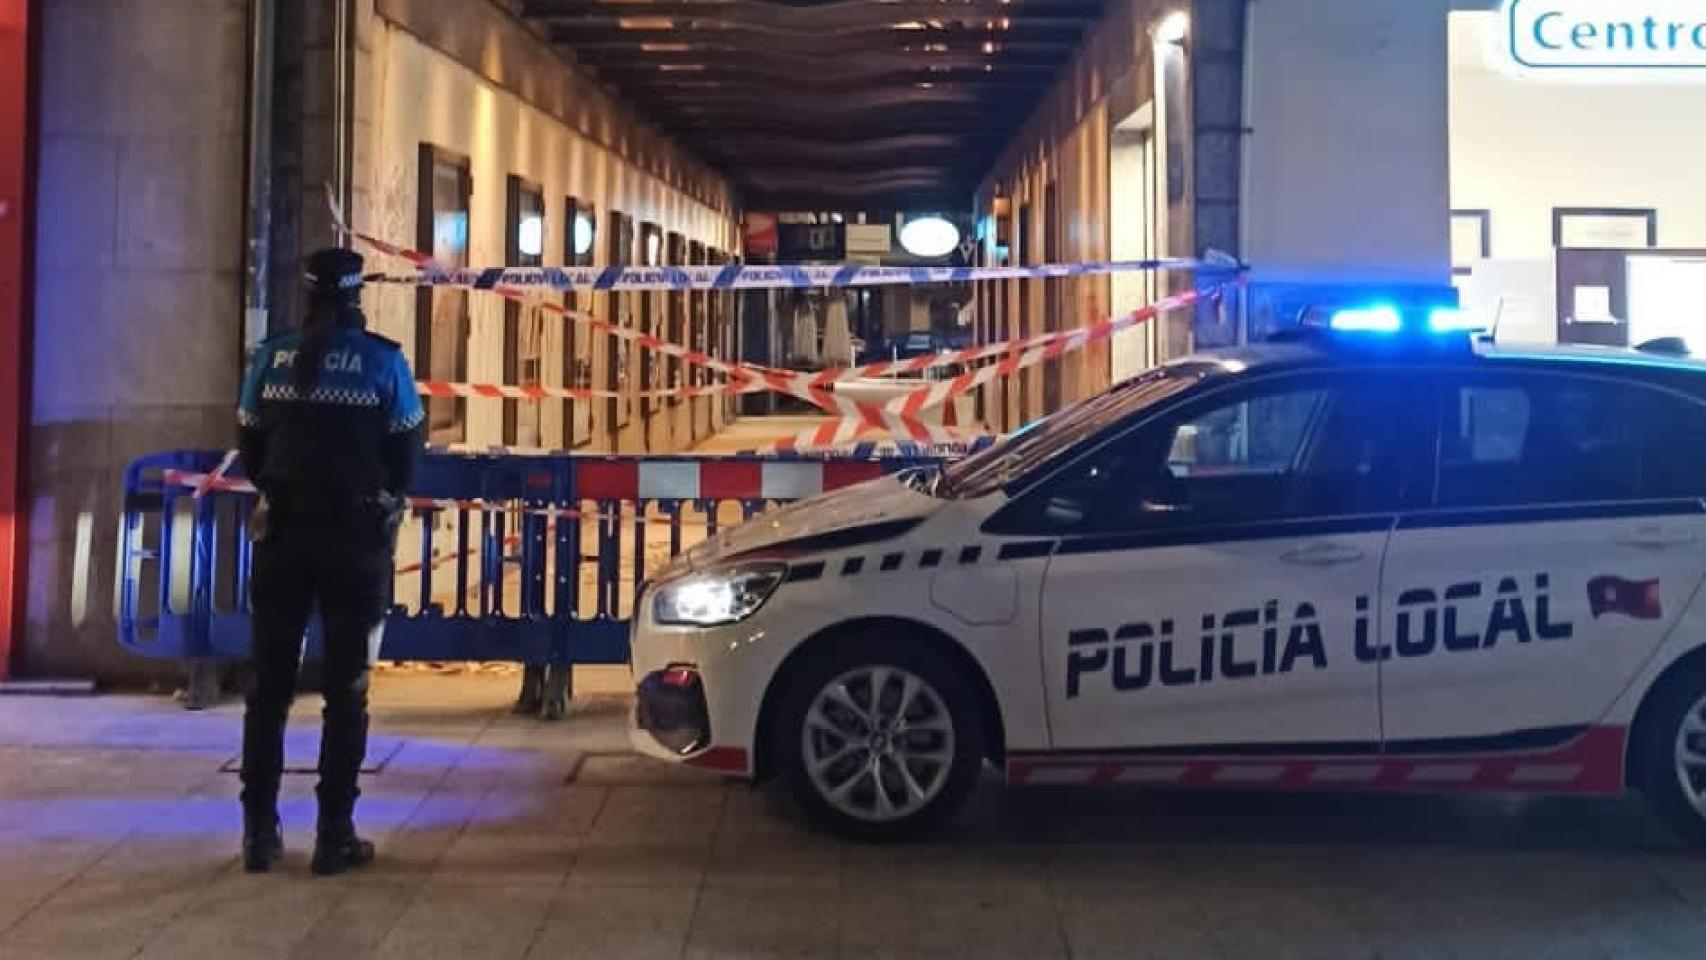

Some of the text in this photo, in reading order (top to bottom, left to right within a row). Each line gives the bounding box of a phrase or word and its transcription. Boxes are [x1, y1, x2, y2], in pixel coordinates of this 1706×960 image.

[1532, 10, 1706, 50] Centro
[1065, 572, 1573, 700] POLICÍA LOCAL
